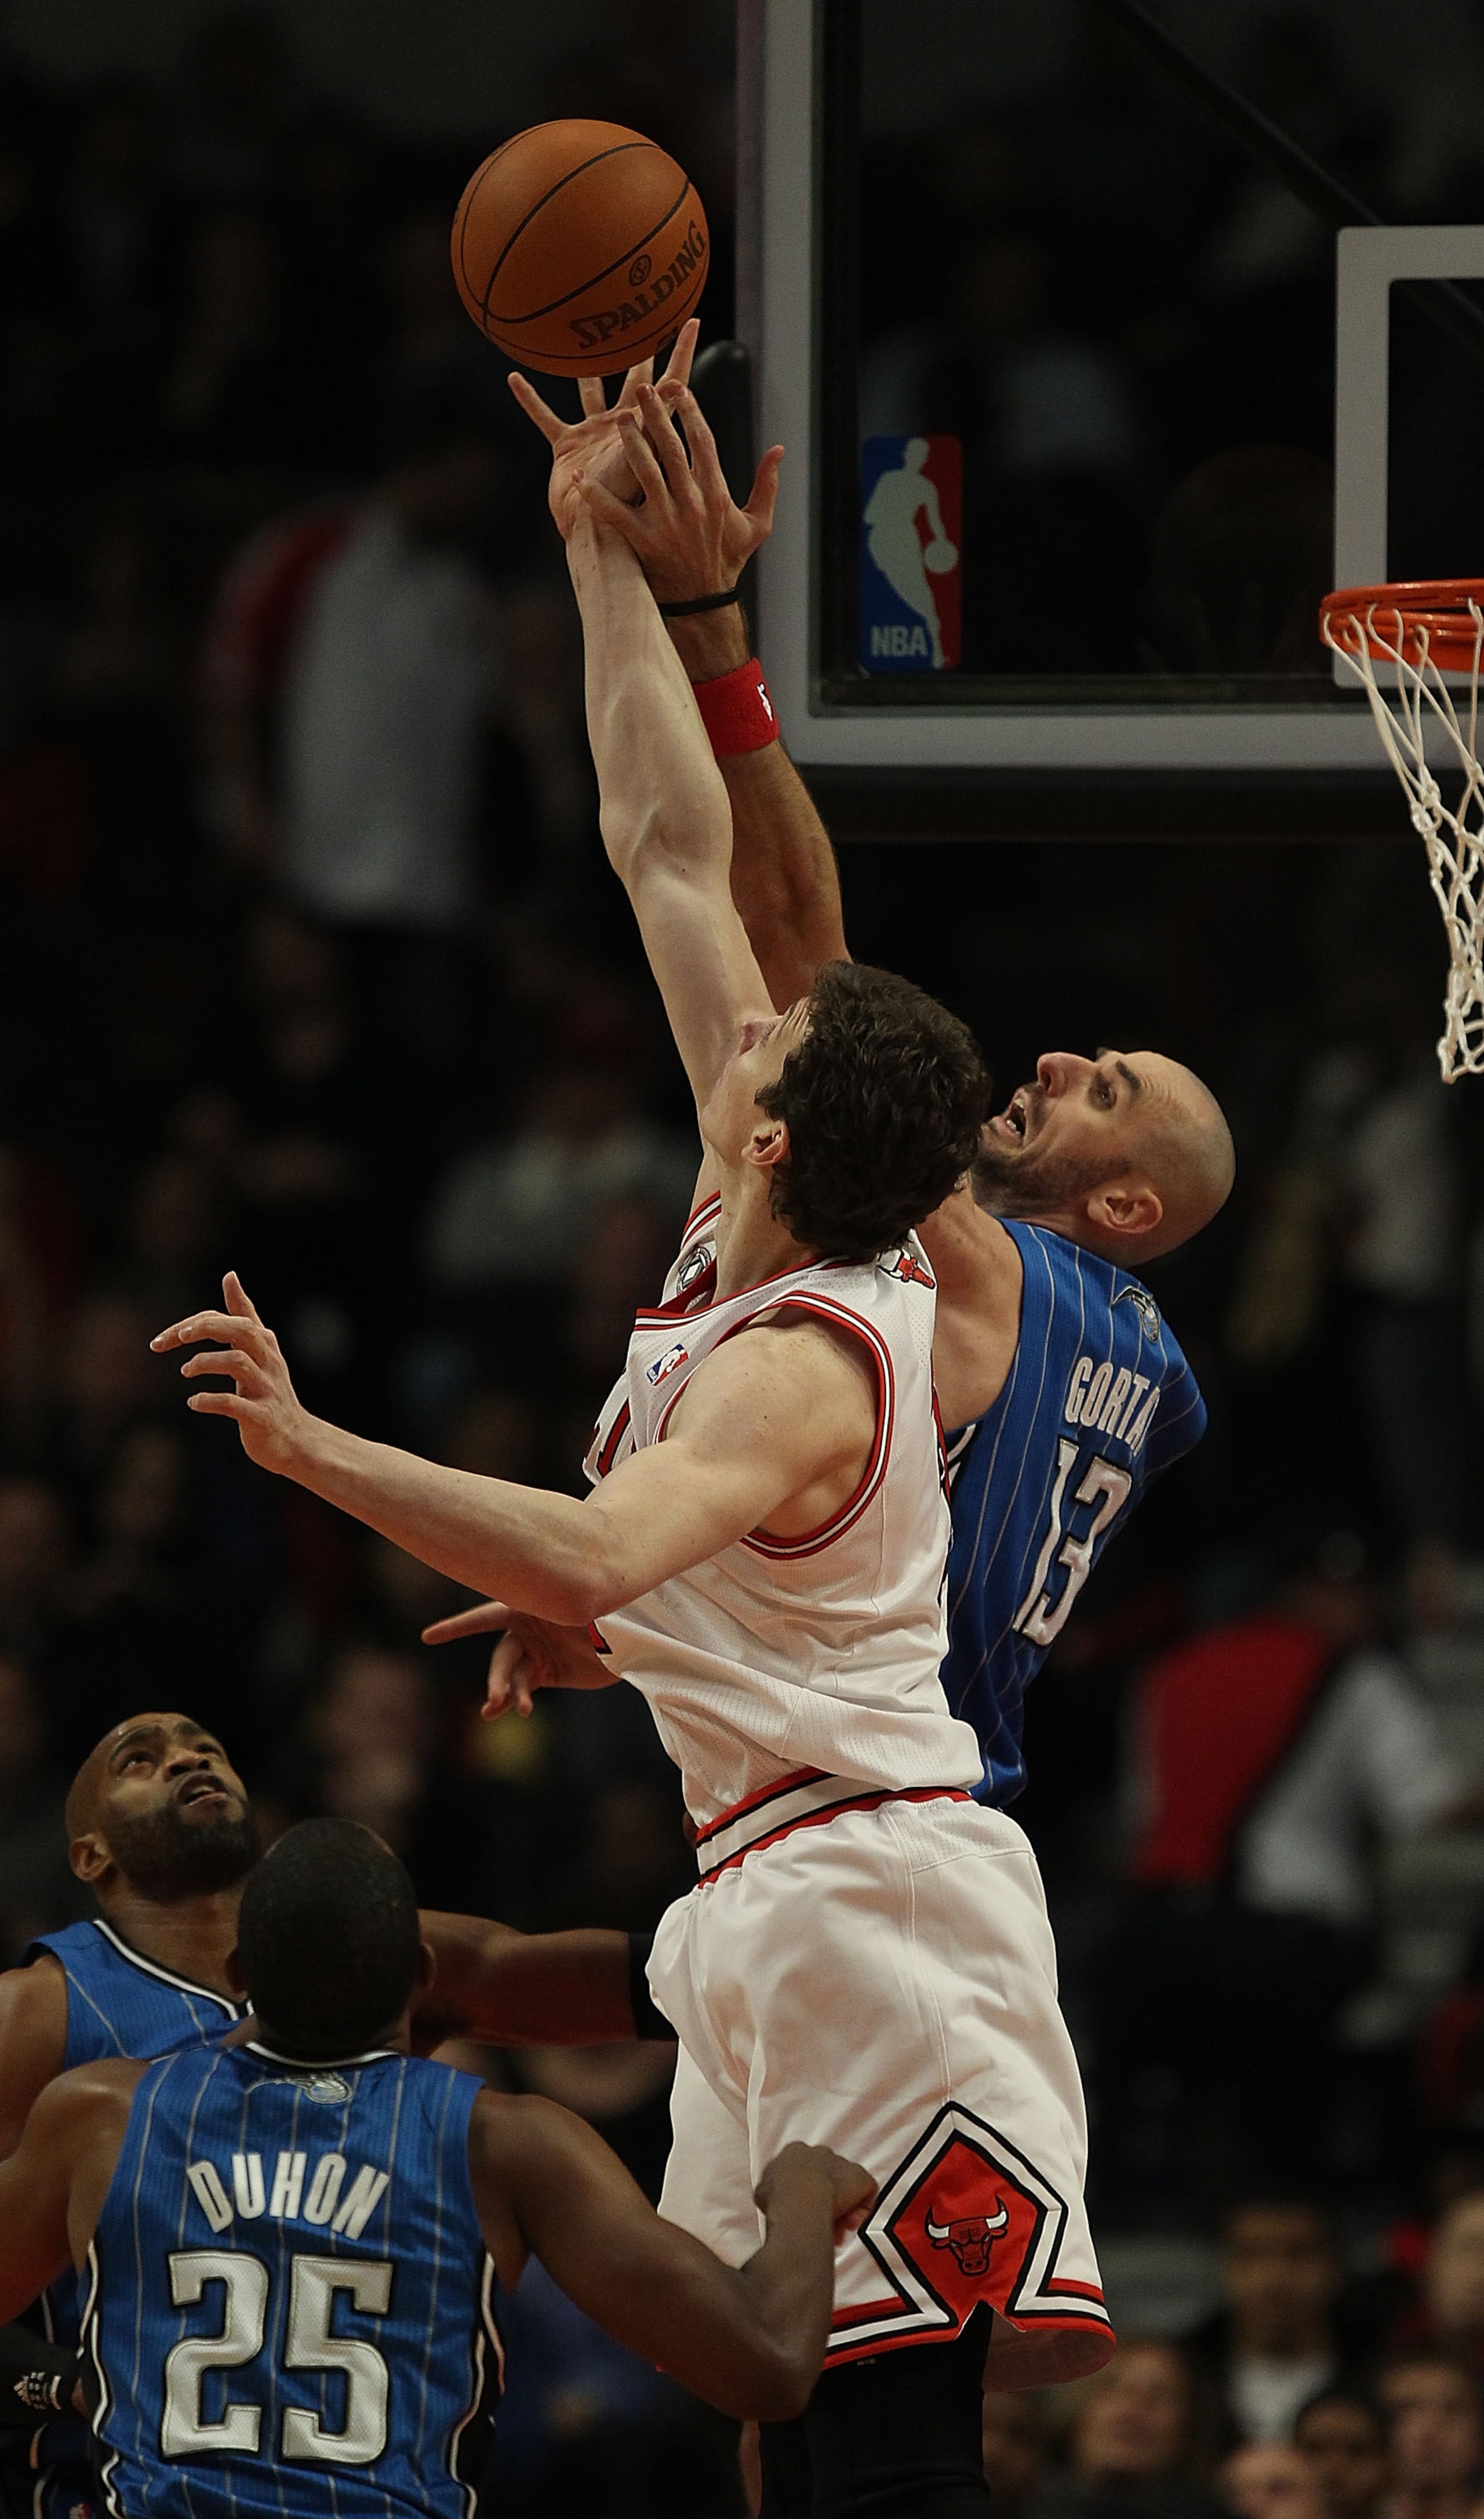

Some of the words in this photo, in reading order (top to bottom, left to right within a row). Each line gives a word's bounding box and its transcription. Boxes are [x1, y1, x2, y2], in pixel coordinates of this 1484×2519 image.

[570, 220, 705, 350] SPALDING
[870, 625, 929, 658] NBA
[1013, 1438, 1133, 1647] 13
[186, 2151, 390, 2241] DUHON
[162, 2249, 394, 2463] 25
